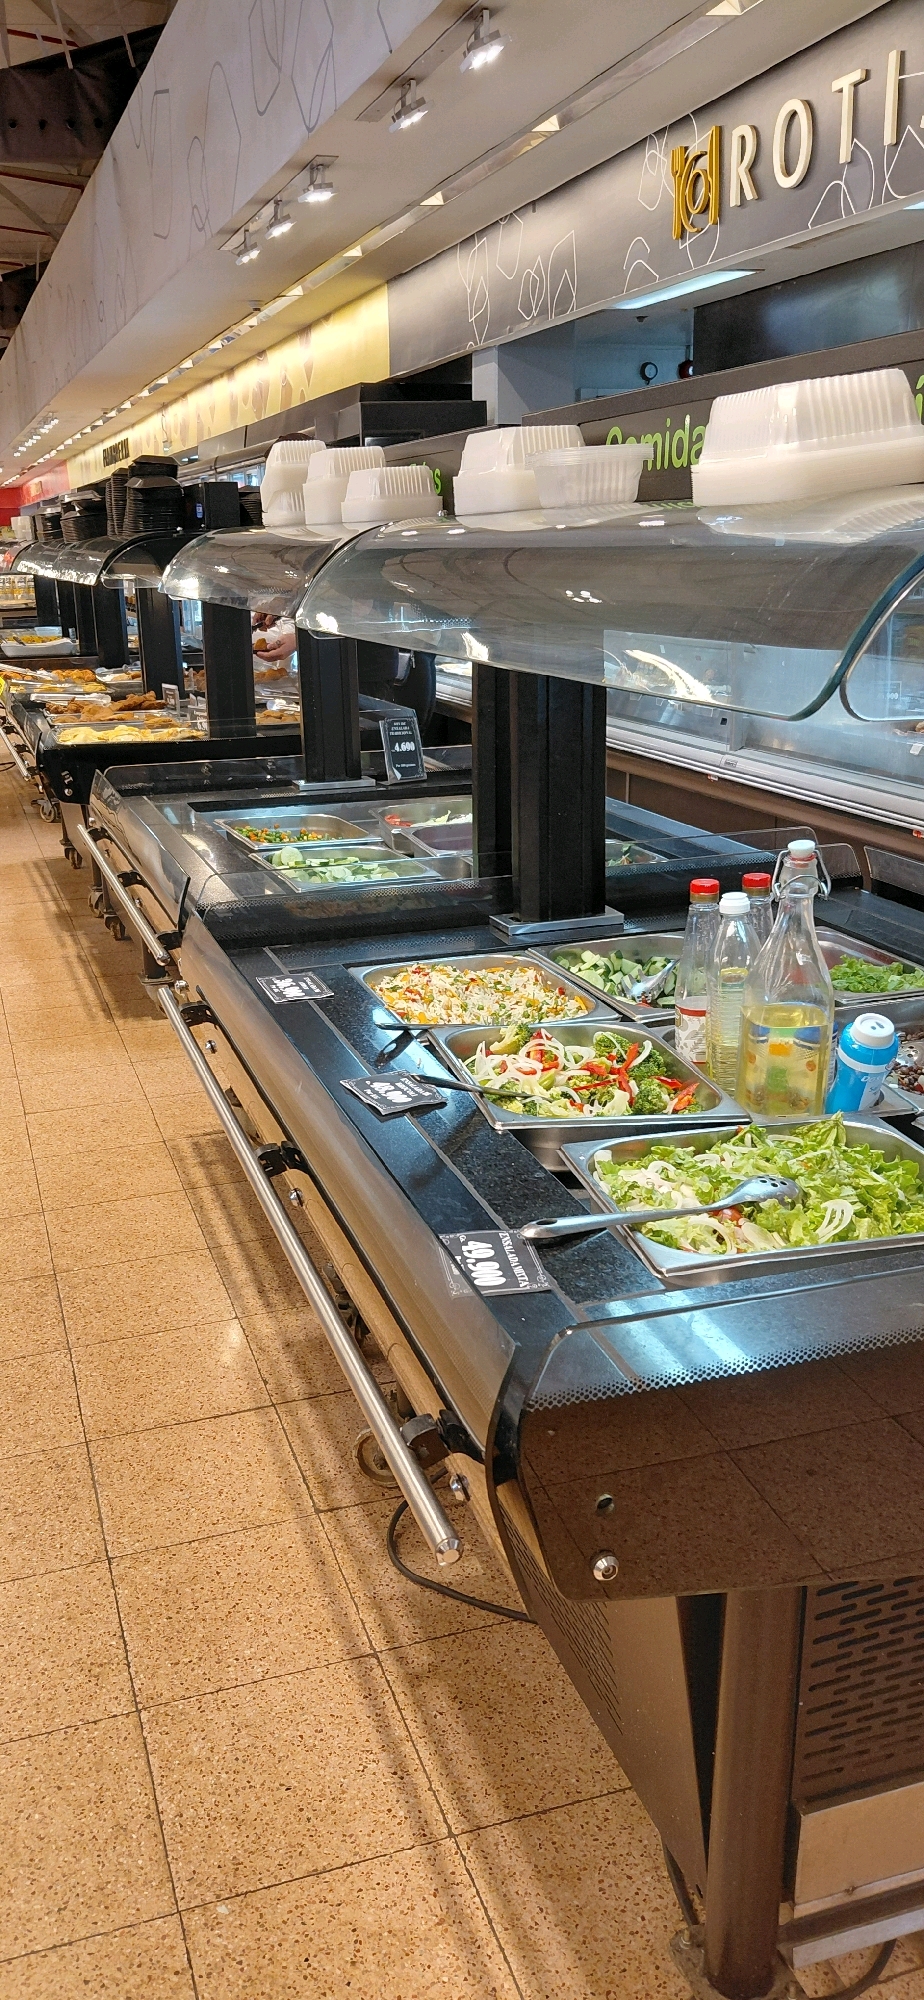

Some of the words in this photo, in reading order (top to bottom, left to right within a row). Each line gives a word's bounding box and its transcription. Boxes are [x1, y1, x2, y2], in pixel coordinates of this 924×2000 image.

[729, 49, 924, 208] ROTI
[394, 741, 415, 752] 4.690
[461, 1240, 507, 1287] 49.900
[498, 1232, 519, 1267] ENSALADA
